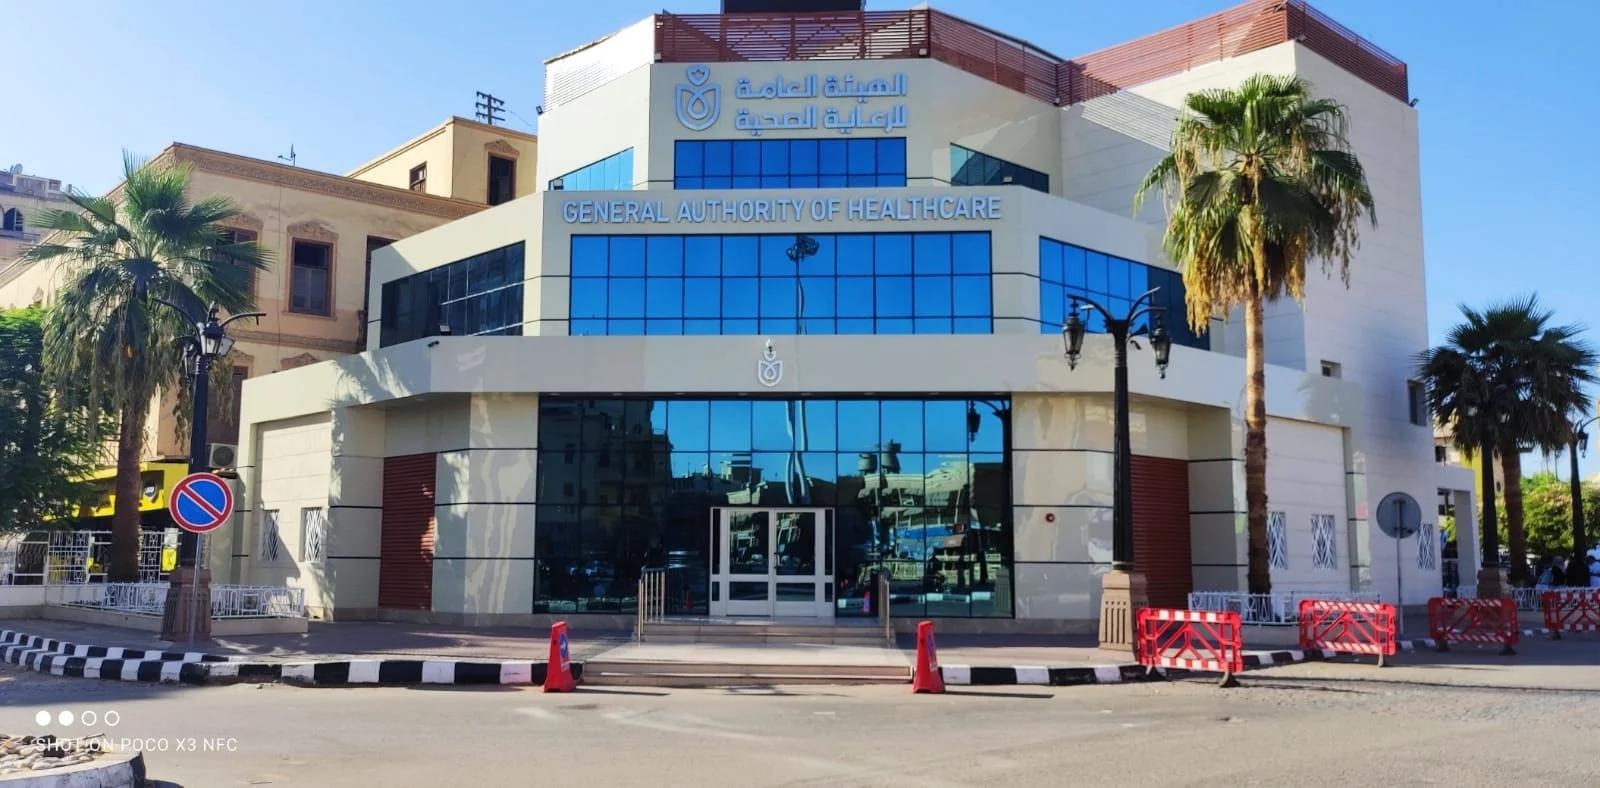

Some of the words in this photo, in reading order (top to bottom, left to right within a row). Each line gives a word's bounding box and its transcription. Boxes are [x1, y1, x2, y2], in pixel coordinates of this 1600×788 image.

[736, 74, 817, 99] العامة
[823, 73, 907, 103] الهيئة
[736, 105, 817, 136] الصحية
[823, 103, 907, 134] للرعاية
[562, 201, 671, 224] GENERAL
[677, 200, 804, 223] AUTHORITY
[811, 199, 841, 221] OF
[847, 196, 1002, 220] HEALTHCARE
